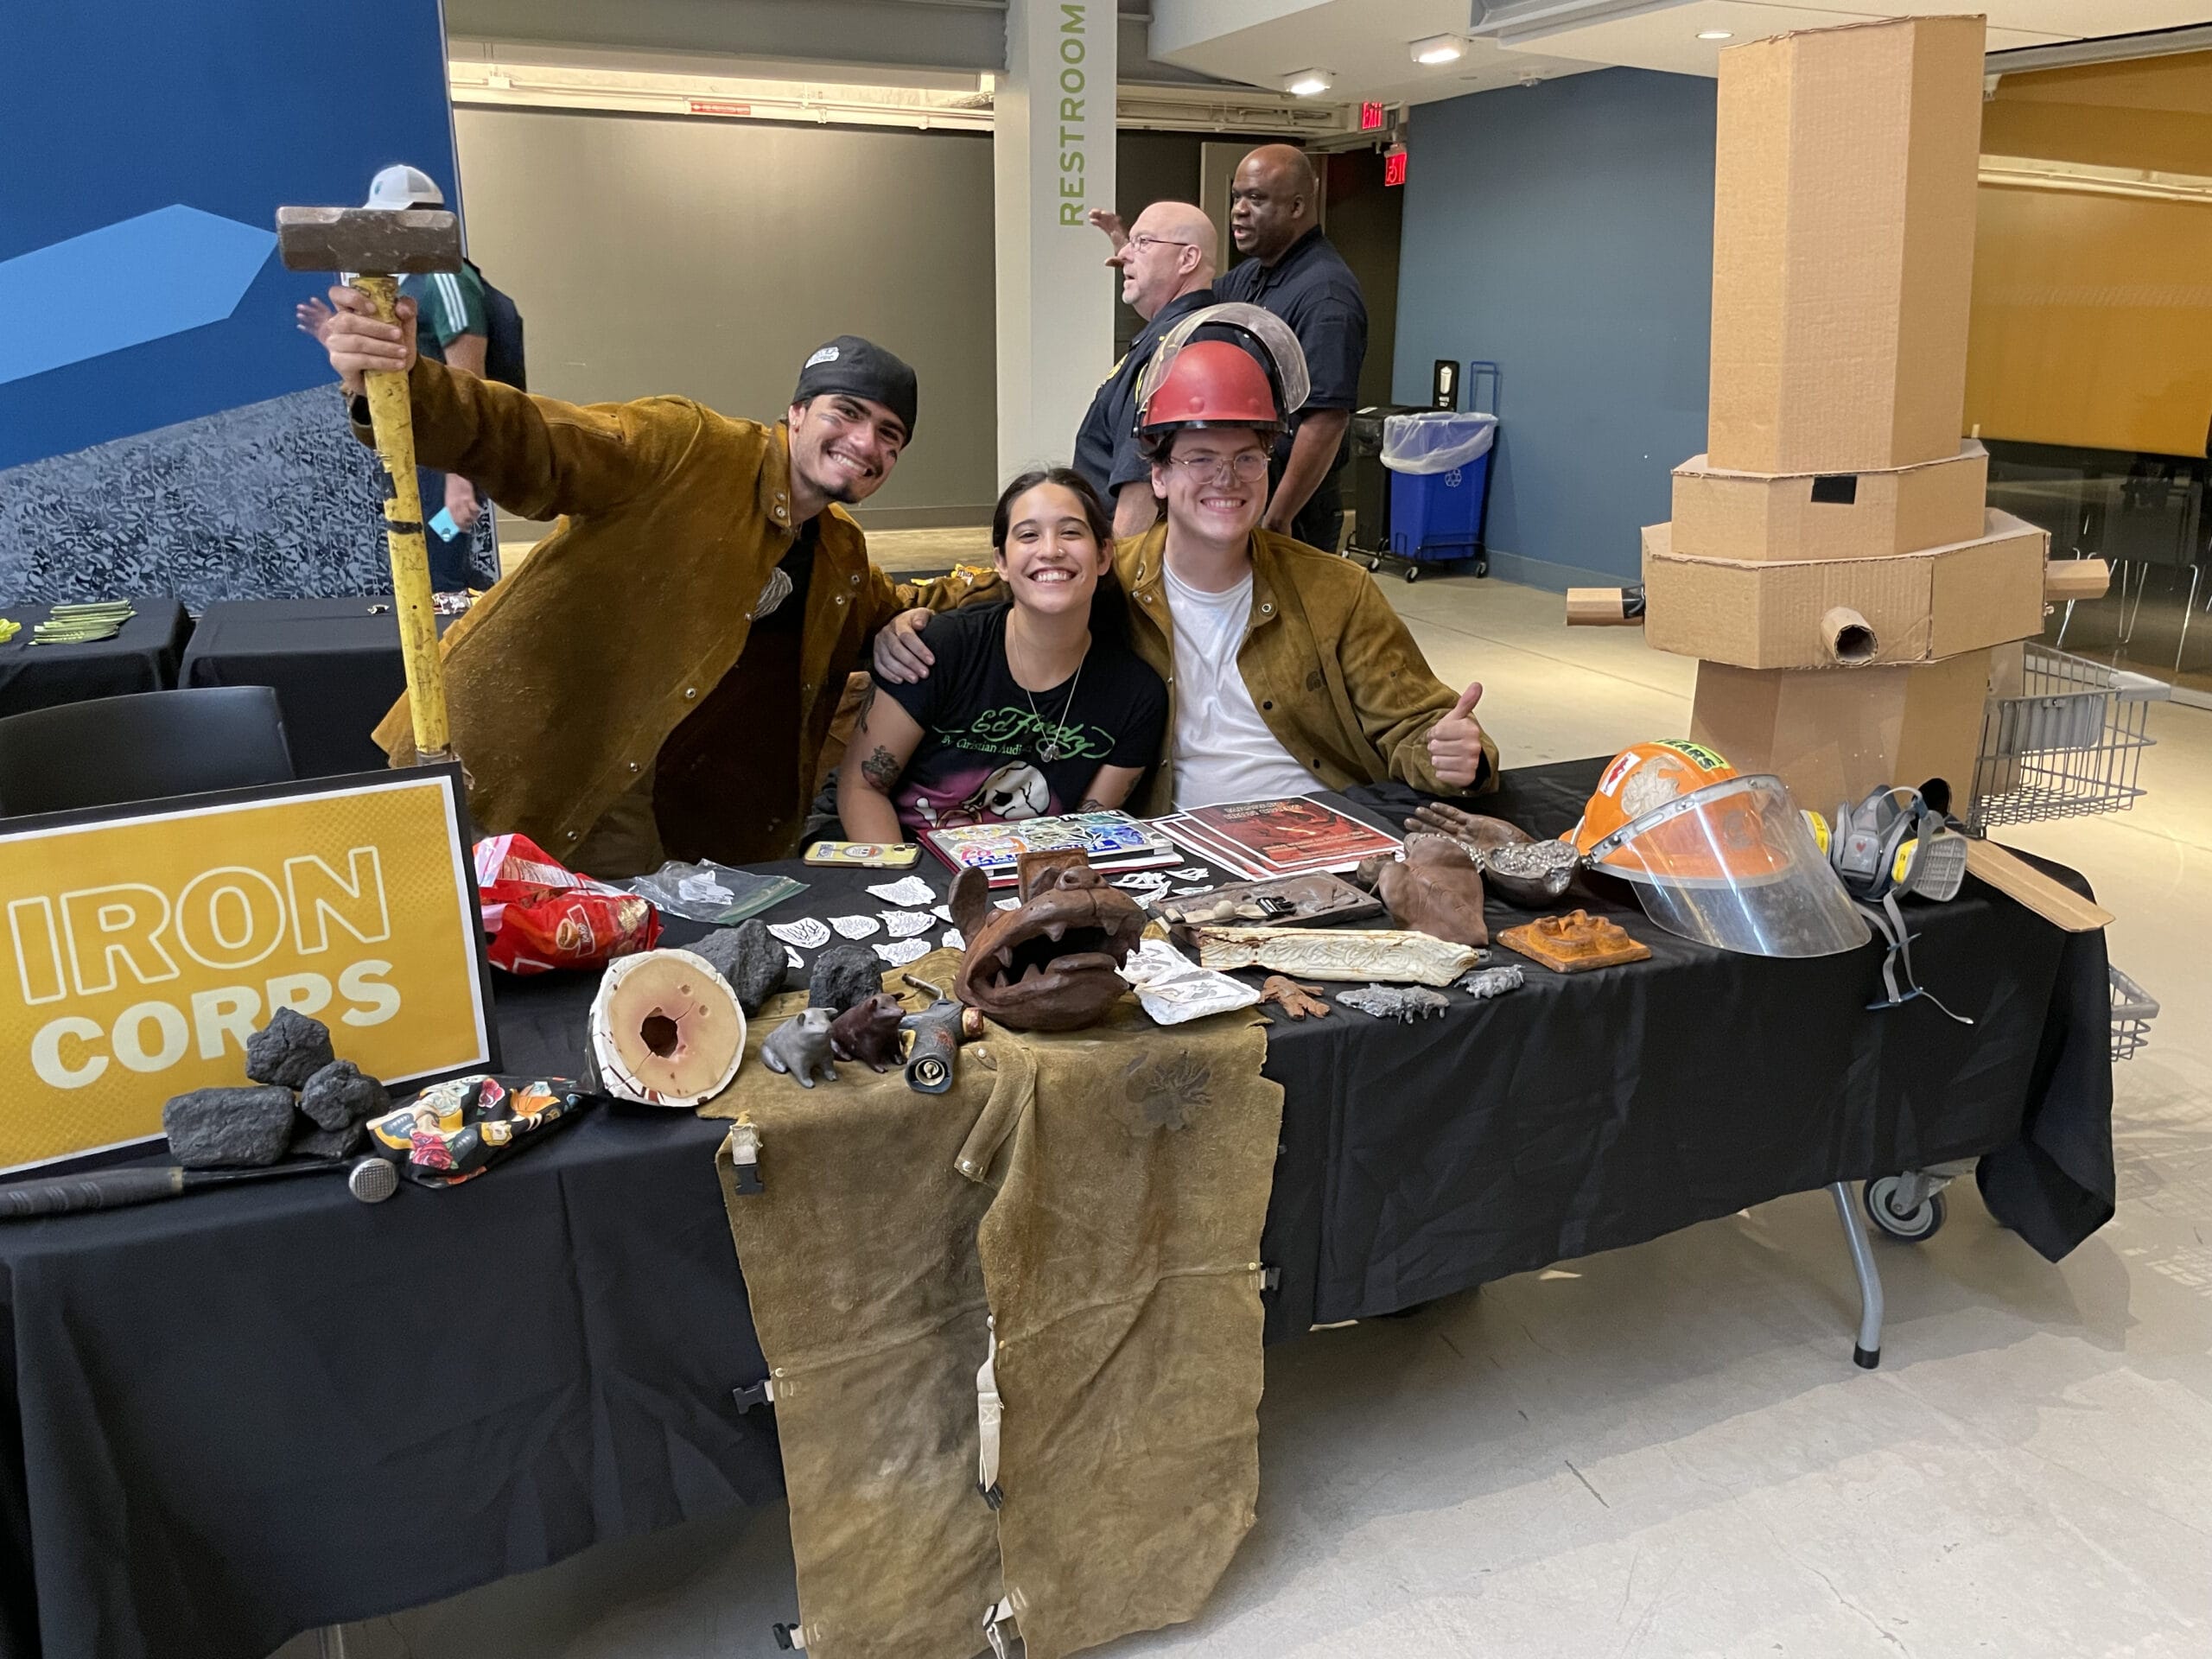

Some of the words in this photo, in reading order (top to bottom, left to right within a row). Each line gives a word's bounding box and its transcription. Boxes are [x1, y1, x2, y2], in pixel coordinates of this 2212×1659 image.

[1059, 3, 1086, 226] RESTROOM
[956, 738, 997, 754] Christian
[971, 709, 1017, 733] Ed
[8, 845, 391, 1006] IRON
[31, 959, 401, 1090] CORPS
